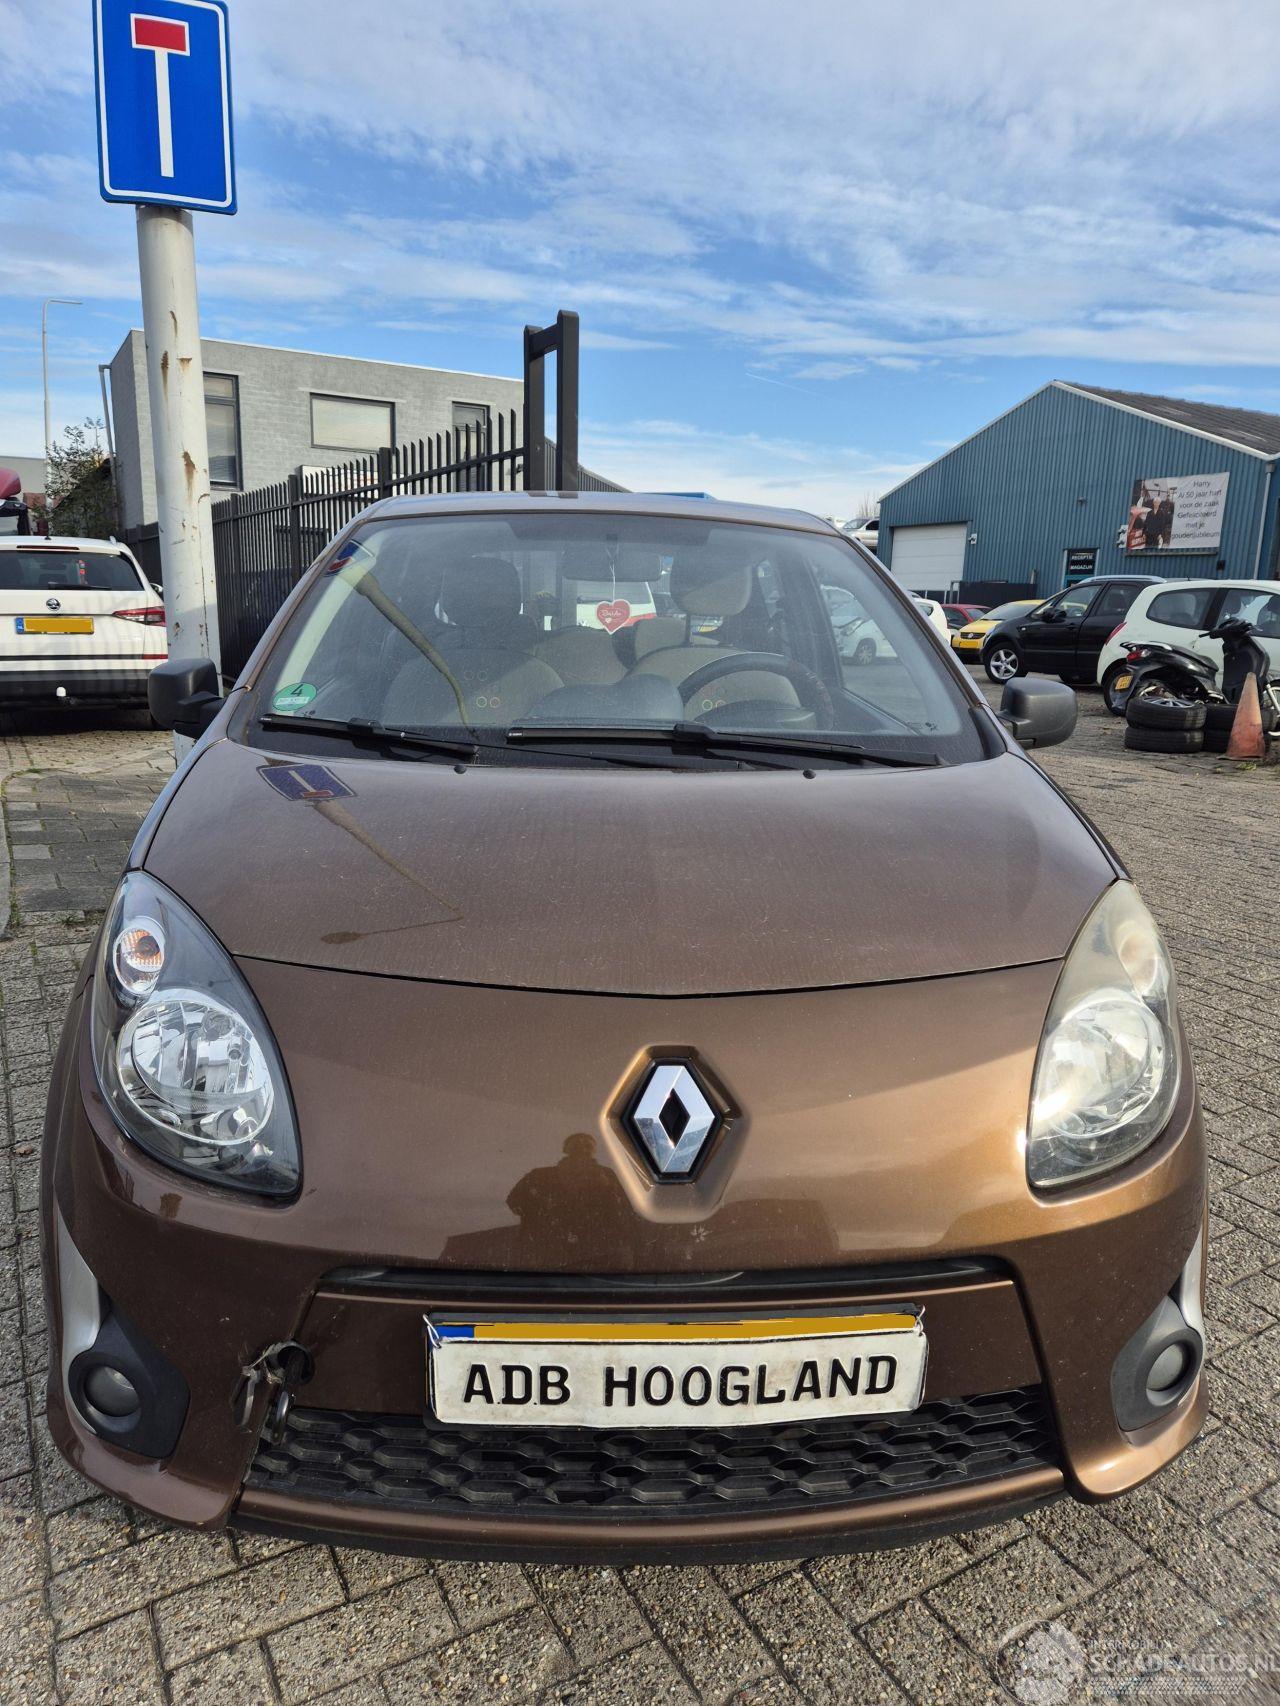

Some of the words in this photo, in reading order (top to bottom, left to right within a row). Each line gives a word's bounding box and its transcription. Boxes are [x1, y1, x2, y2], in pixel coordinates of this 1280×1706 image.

[1186, 490, 1194, 498] 50
[1195, 491, 1208, 499] jaar
[1198, 521, 1206, 529] je
[291, 683, 304, 697] 4
[603, 1354, 898, 1408] HOOGLAND
